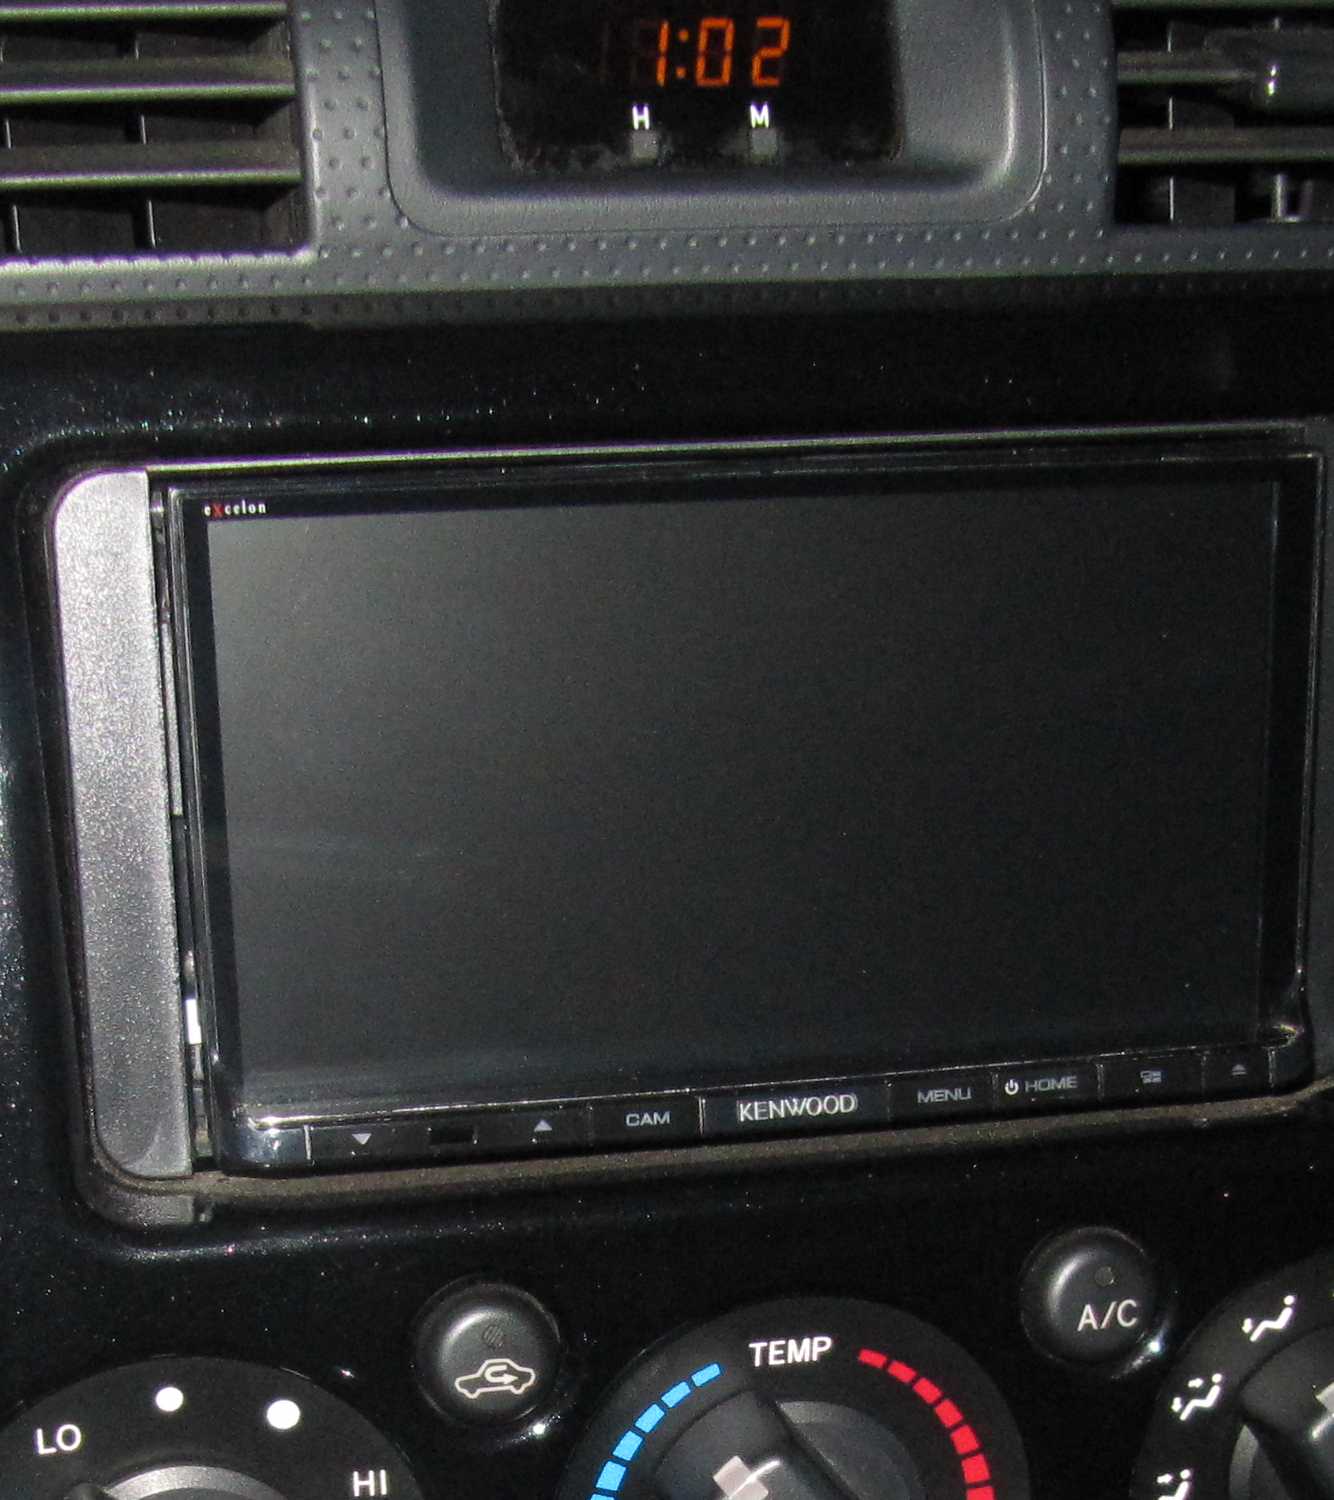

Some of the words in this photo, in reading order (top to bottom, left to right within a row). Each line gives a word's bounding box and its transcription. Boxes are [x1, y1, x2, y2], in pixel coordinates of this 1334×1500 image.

[655, 17, 791, 87] 1:02
[631, 103, 651, 131] H
[749, 103, 770, 128] M
[917, 1087, 972, 1104] MENU
[1024, 1075, 1078, 1093] HOME
[625, 1111, 671, 1127] CAM
[739, 1093, 858, 1122] KENWOOD
[1077, 1299, 1138, 1332] A/C
[748, 1336, 833, 1368] TEMP
[35, 1423, 82, 1456] LO
[352, 1469, 388, 1498] HI
